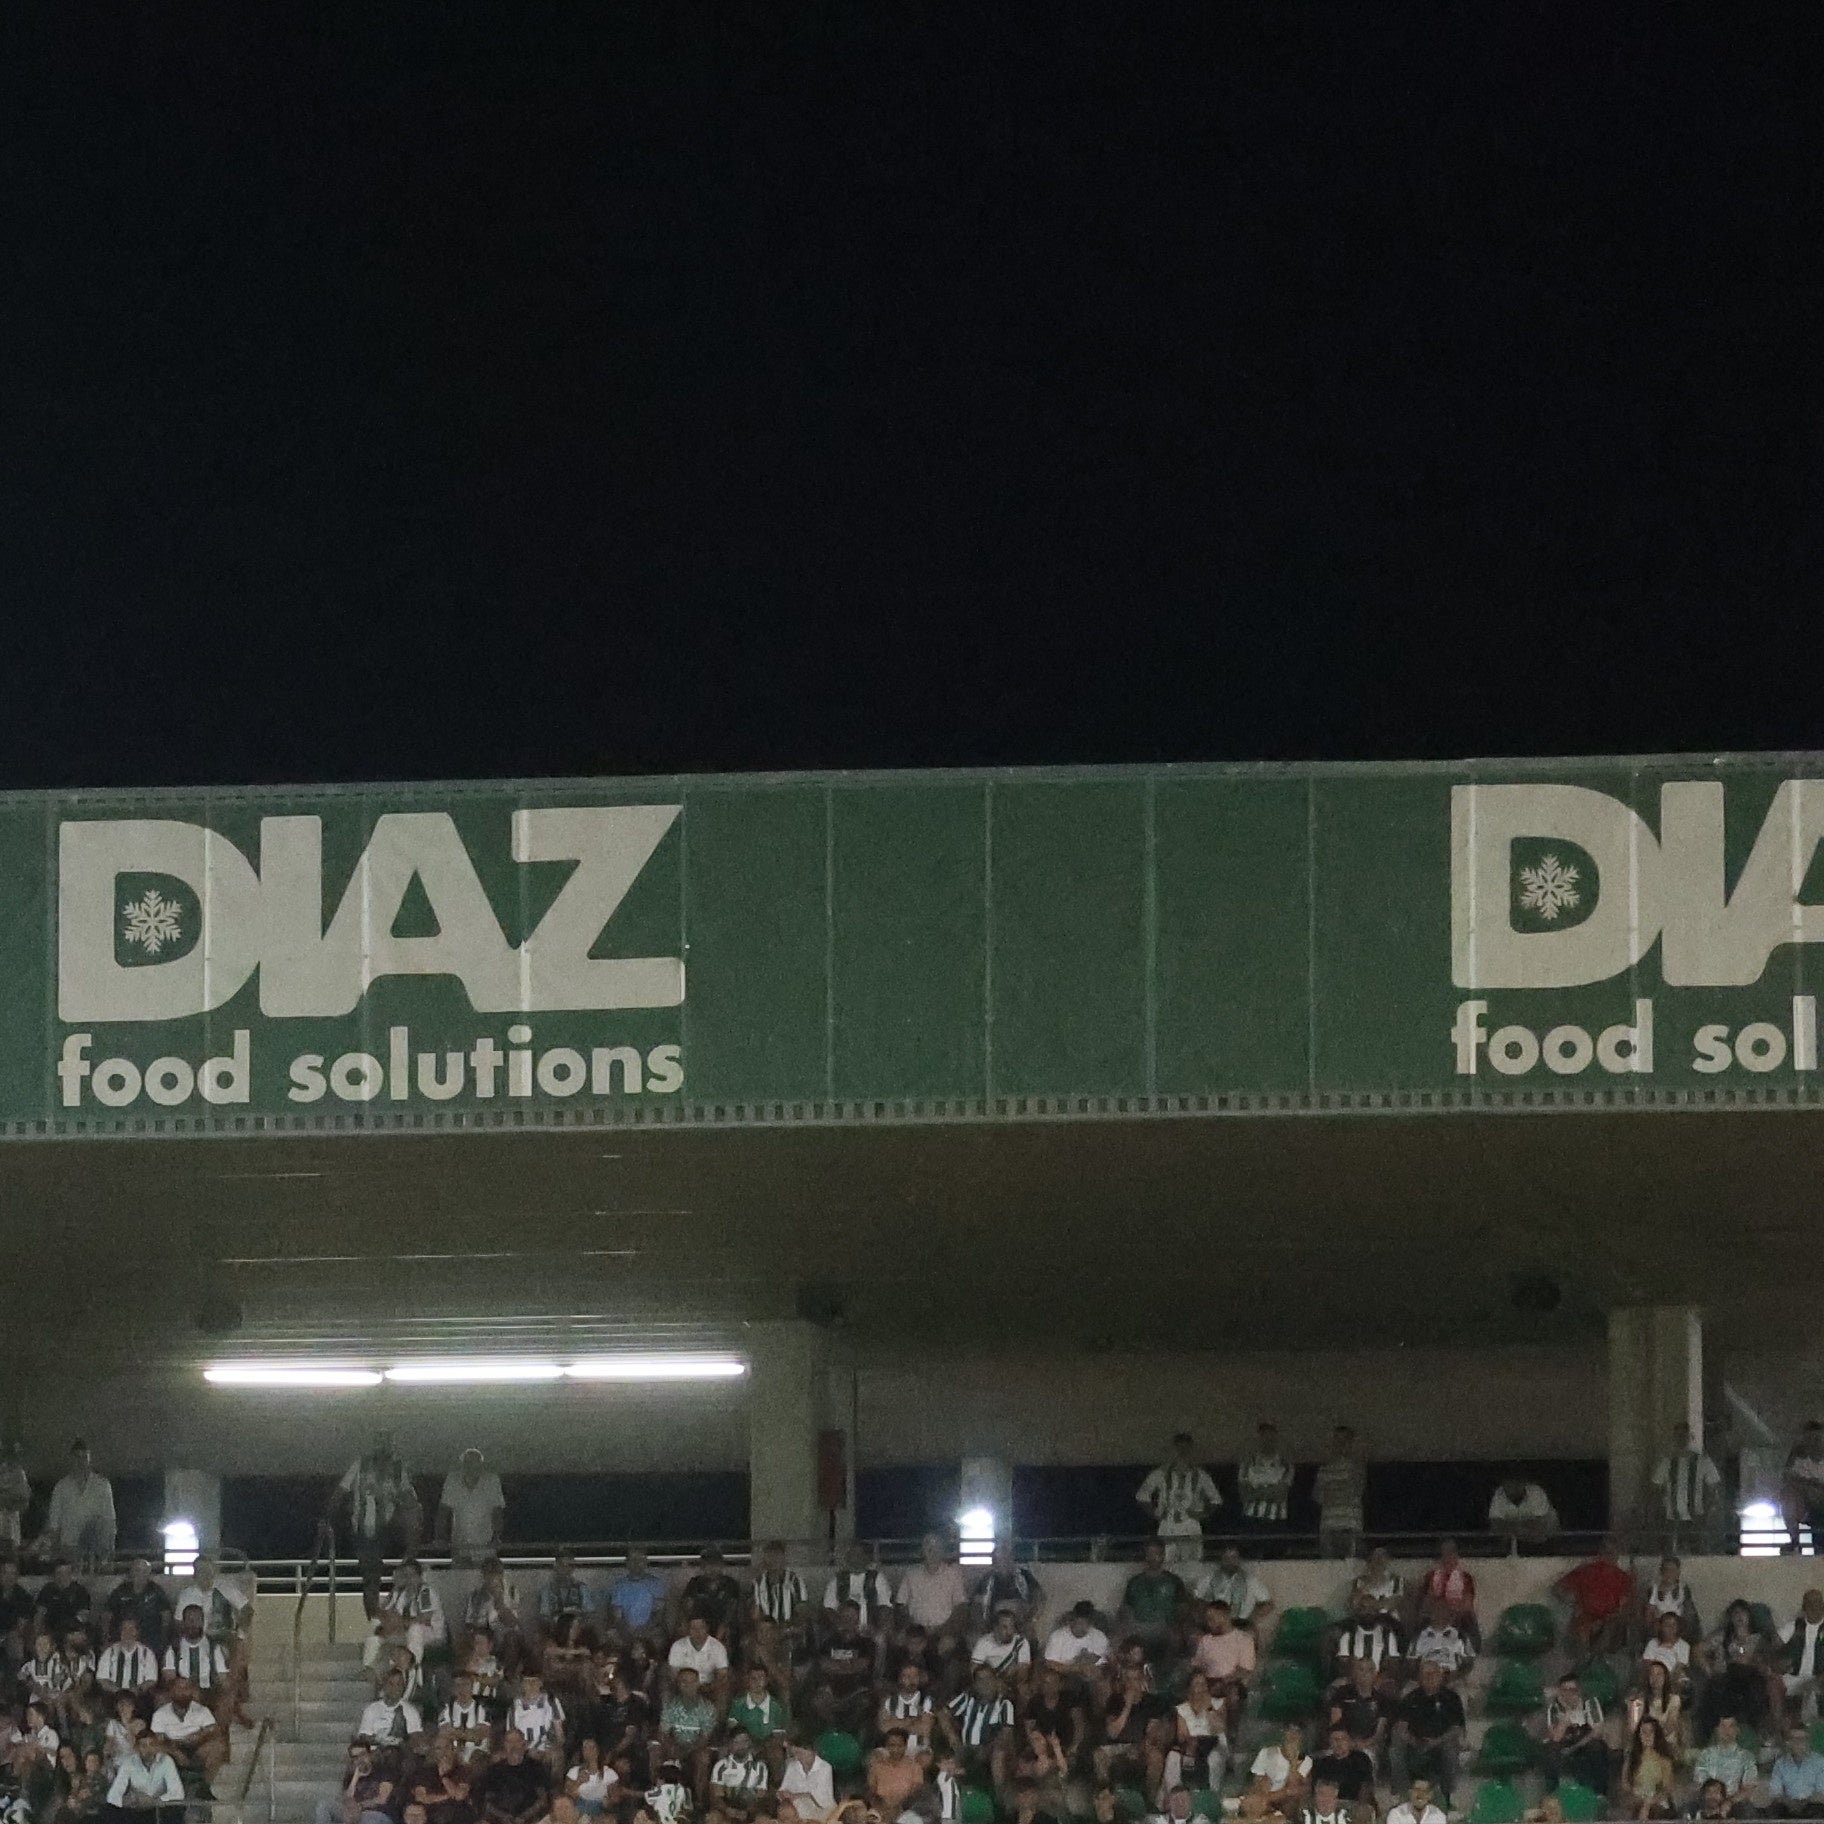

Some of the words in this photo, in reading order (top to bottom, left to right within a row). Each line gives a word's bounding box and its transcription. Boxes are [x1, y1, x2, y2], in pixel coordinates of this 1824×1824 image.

[59, 805, 685, 1022] DIAZ
[57, 1029, 251, 1107] food
[287, 1025, 685, 1104] solutions
[1451, 999, 1654, 1075] food
